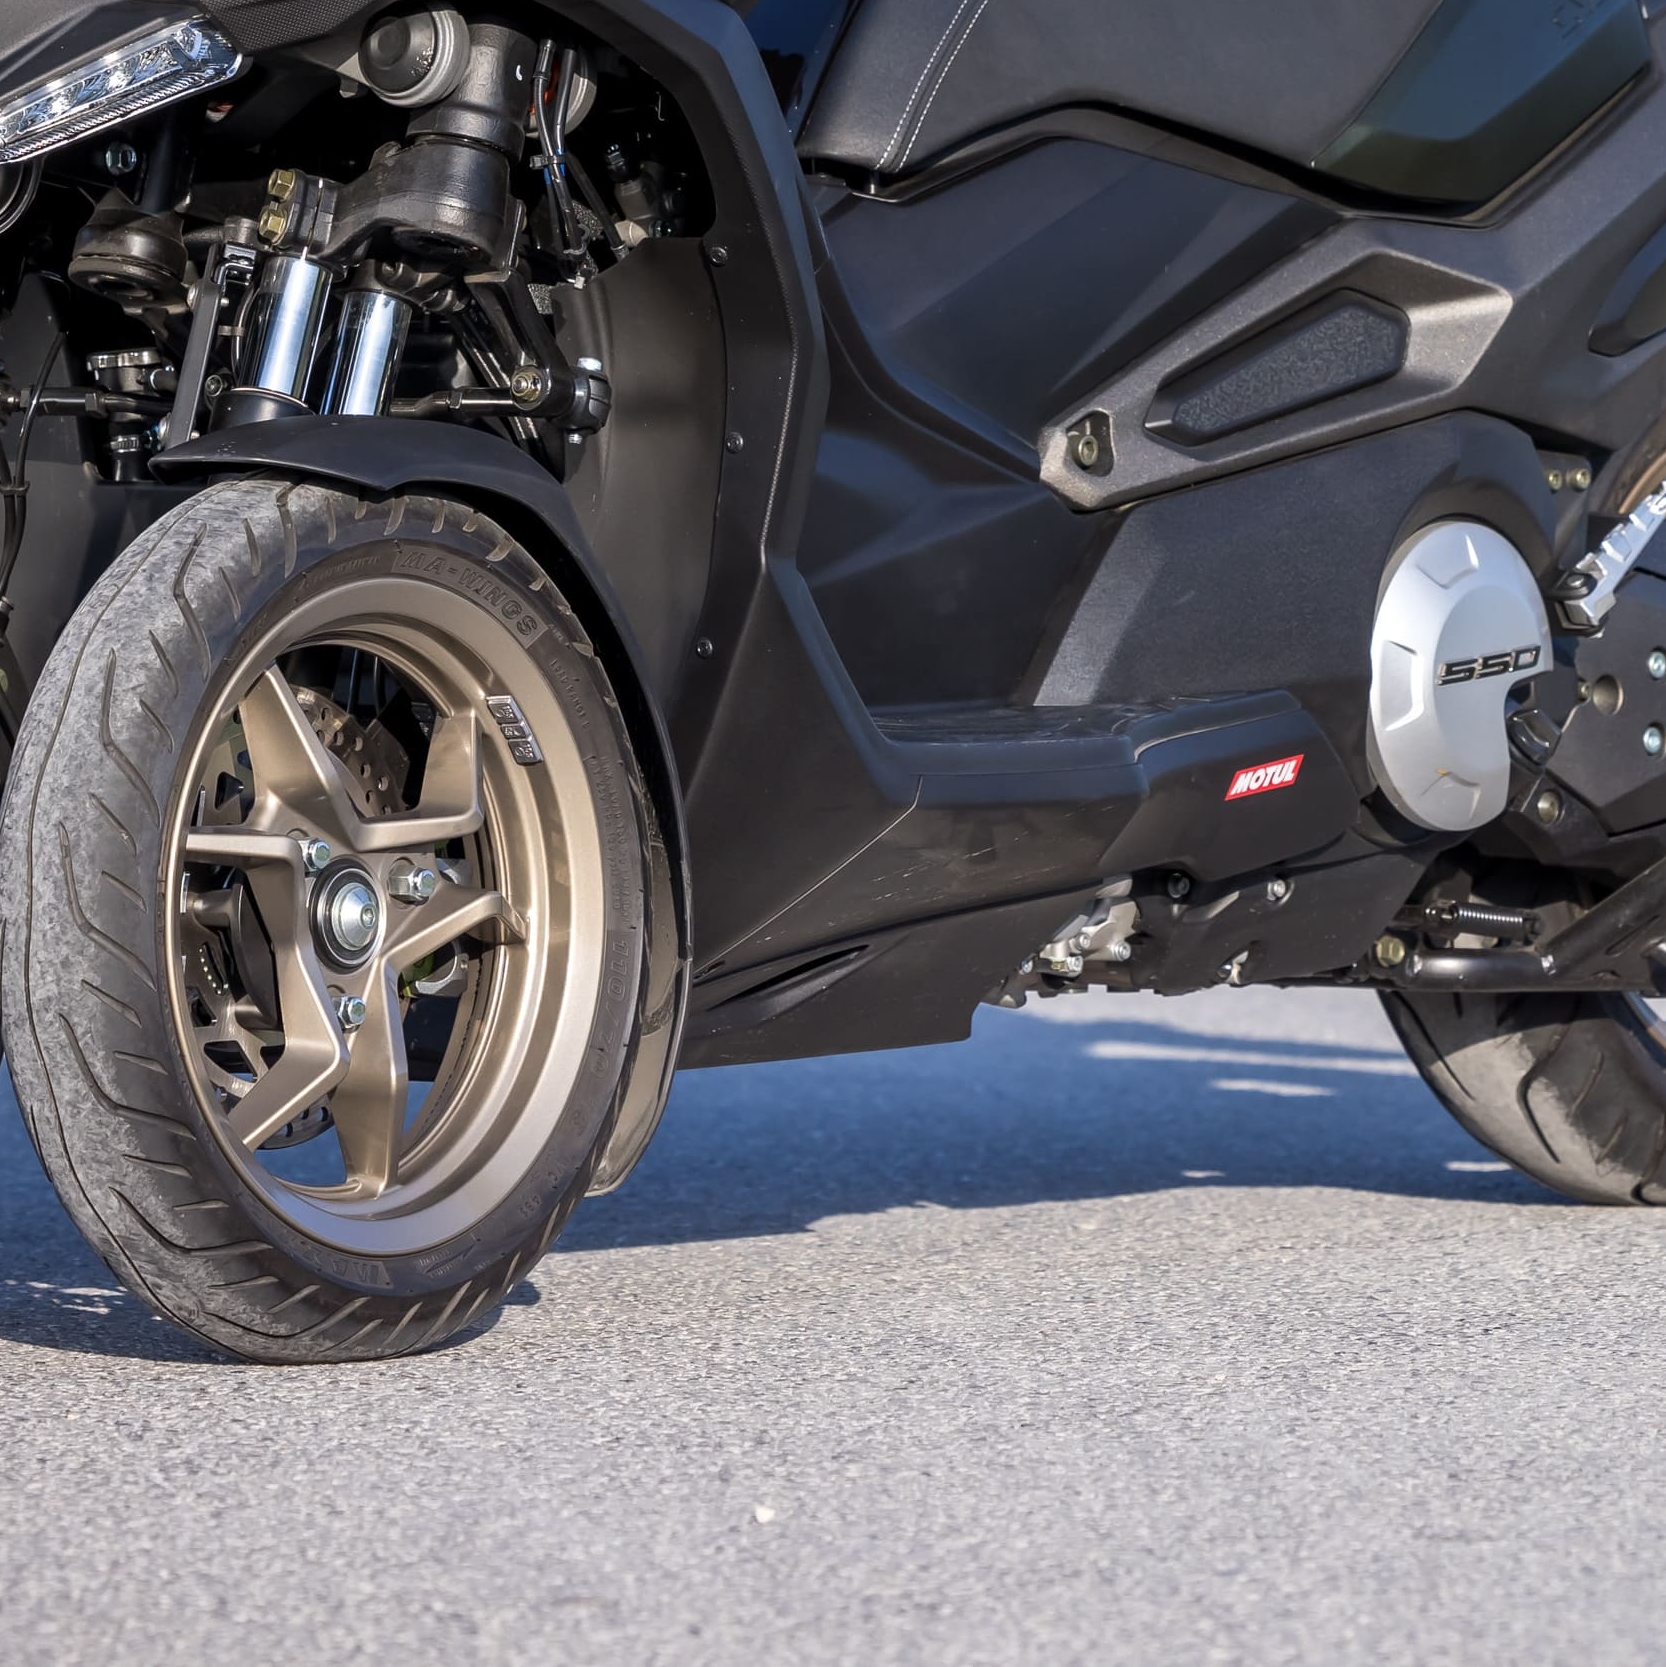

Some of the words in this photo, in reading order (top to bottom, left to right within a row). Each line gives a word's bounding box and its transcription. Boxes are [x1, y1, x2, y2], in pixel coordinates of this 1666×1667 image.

[400, 551, 538, 636] MA-WINGS
[1437, 645, 1542, 686] 550
[1229, 759, 1298, 796] MOTUL
